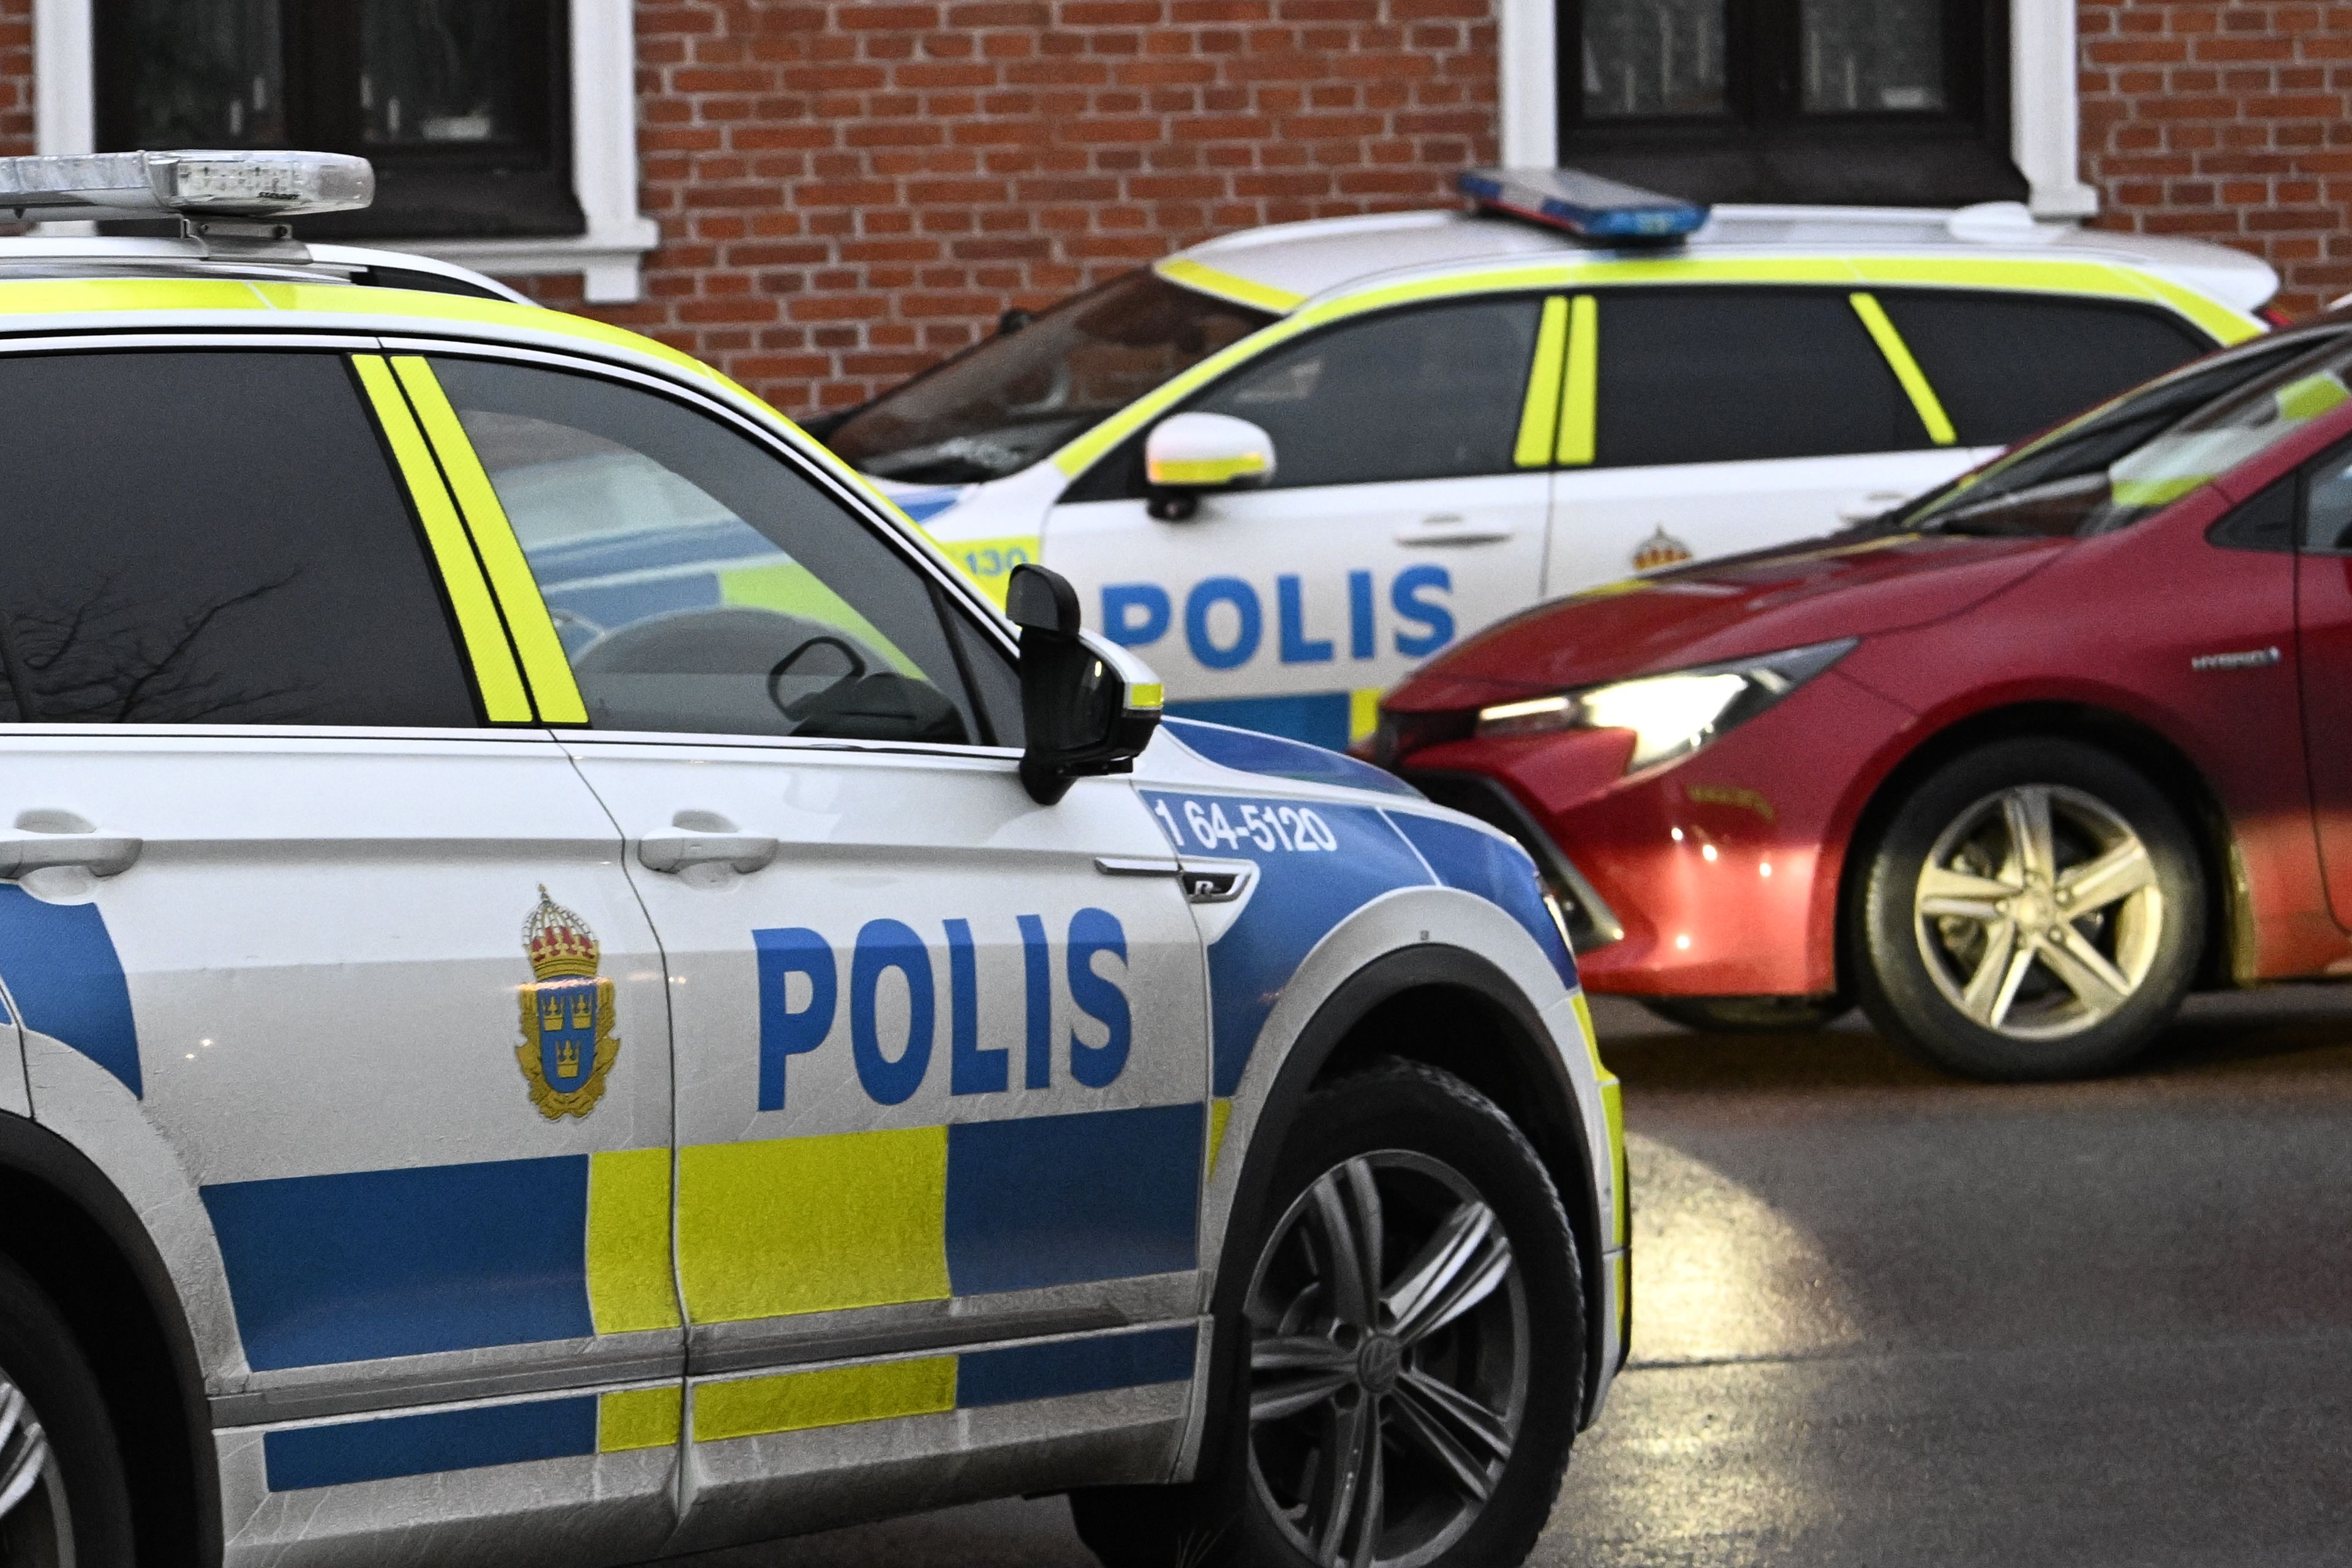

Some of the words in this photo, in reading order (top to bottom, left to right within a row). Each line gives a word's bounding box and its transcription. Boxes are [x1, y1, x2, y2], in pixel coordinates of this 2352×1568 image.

[1101, 564, 1455, 669] POLIS
[1184, 800, 1337, 852] 64-5120
[751, 907, 1131, 1112] POLIS
